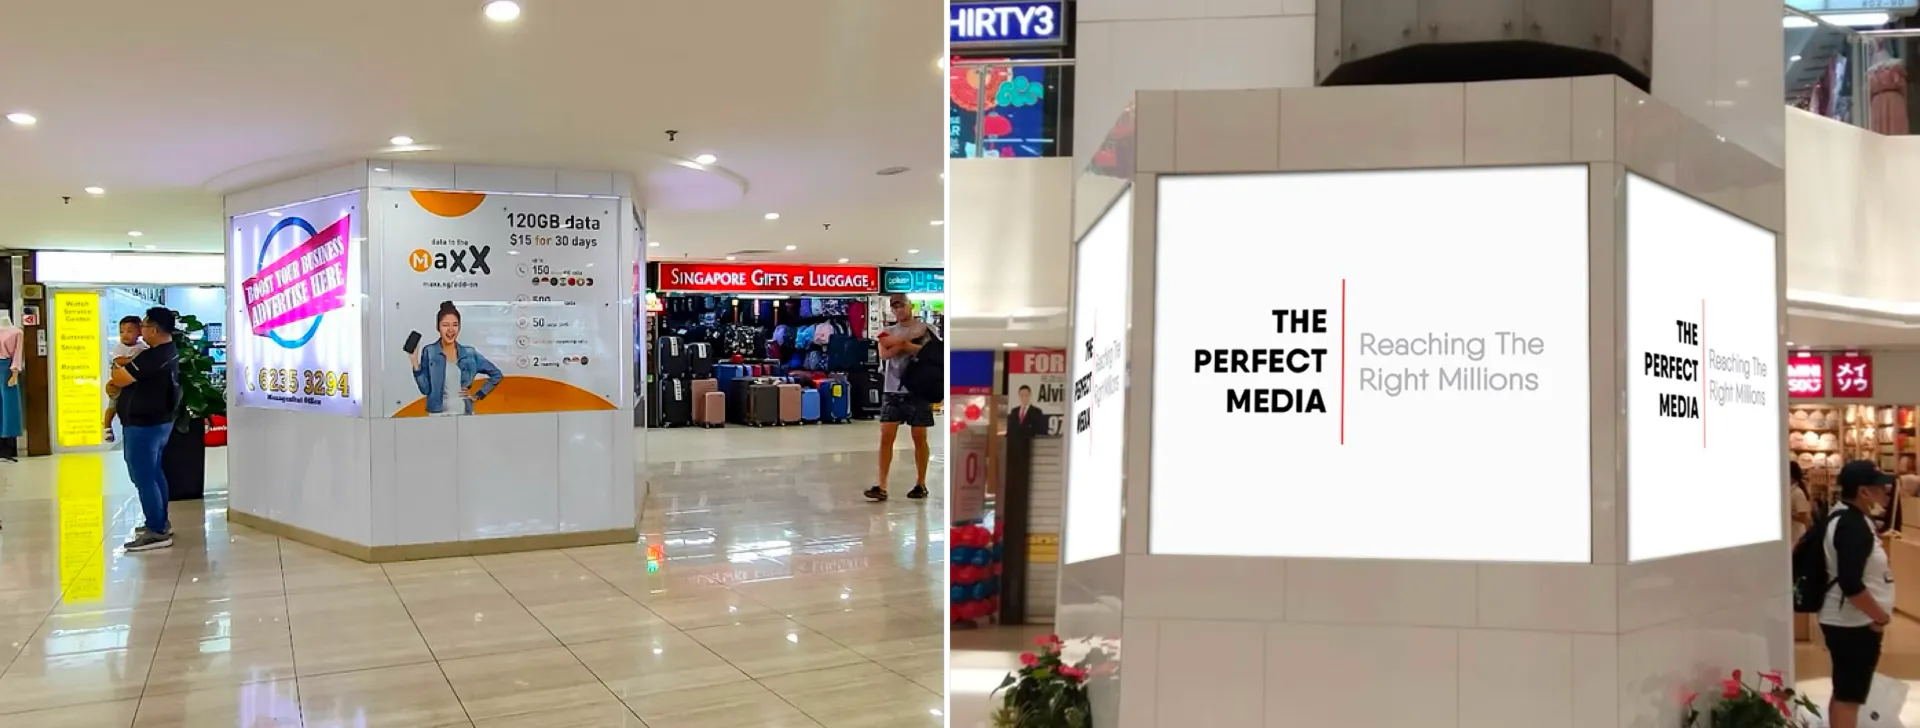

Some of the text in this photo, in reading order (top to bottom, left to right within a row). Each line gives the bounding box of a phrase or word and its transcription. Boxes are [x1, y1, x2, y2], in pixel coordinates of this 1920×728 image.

[507, 212, 601, 231] 120GB data
[509, 234, 598, 249] $15 for 30 days
[247, 236, 344, 300] BOOST YOUR BUSINESS
[532, 265, 550, 275] 150
[671, 267, 746, 285] SINGAPORE
[751, 269, 788, 286] GIFTS
[793, 274, 803, 286] &
[809, 270, 869, 287] LUGGAGE
[252, 263, 343, 327] ADVERTISE HERE
[533, 318, 545, 328] 50
[1272, 309, 1327, 333] THE
[1676, 320, 1698, 346] THE
[1085, 337, 1094, 362] THE
[1360, 332, 1544, 361] Reaching The
[533, 357, 539, 367] 2
[1024, 353, 1064, 373] FOR
[1194, 348, 1327, 373] PERFECT
[1644, 352, 1699, 382] PERFECT
[1709, 349, 1767, 378] Reaching The
[259, 367, 350, 398] 6235 3294
[1074, 371, 1092, 402] PERFECT
[1360, 368, 1539, 397] Right Millions
[1709, 380, 1766, 406] Right Millions
[1226, 389, 1327, 413] MEDIA
[1659, 393, 1699, 419] MEDIA
[1077, 407, 1091, 434] MEDIA
